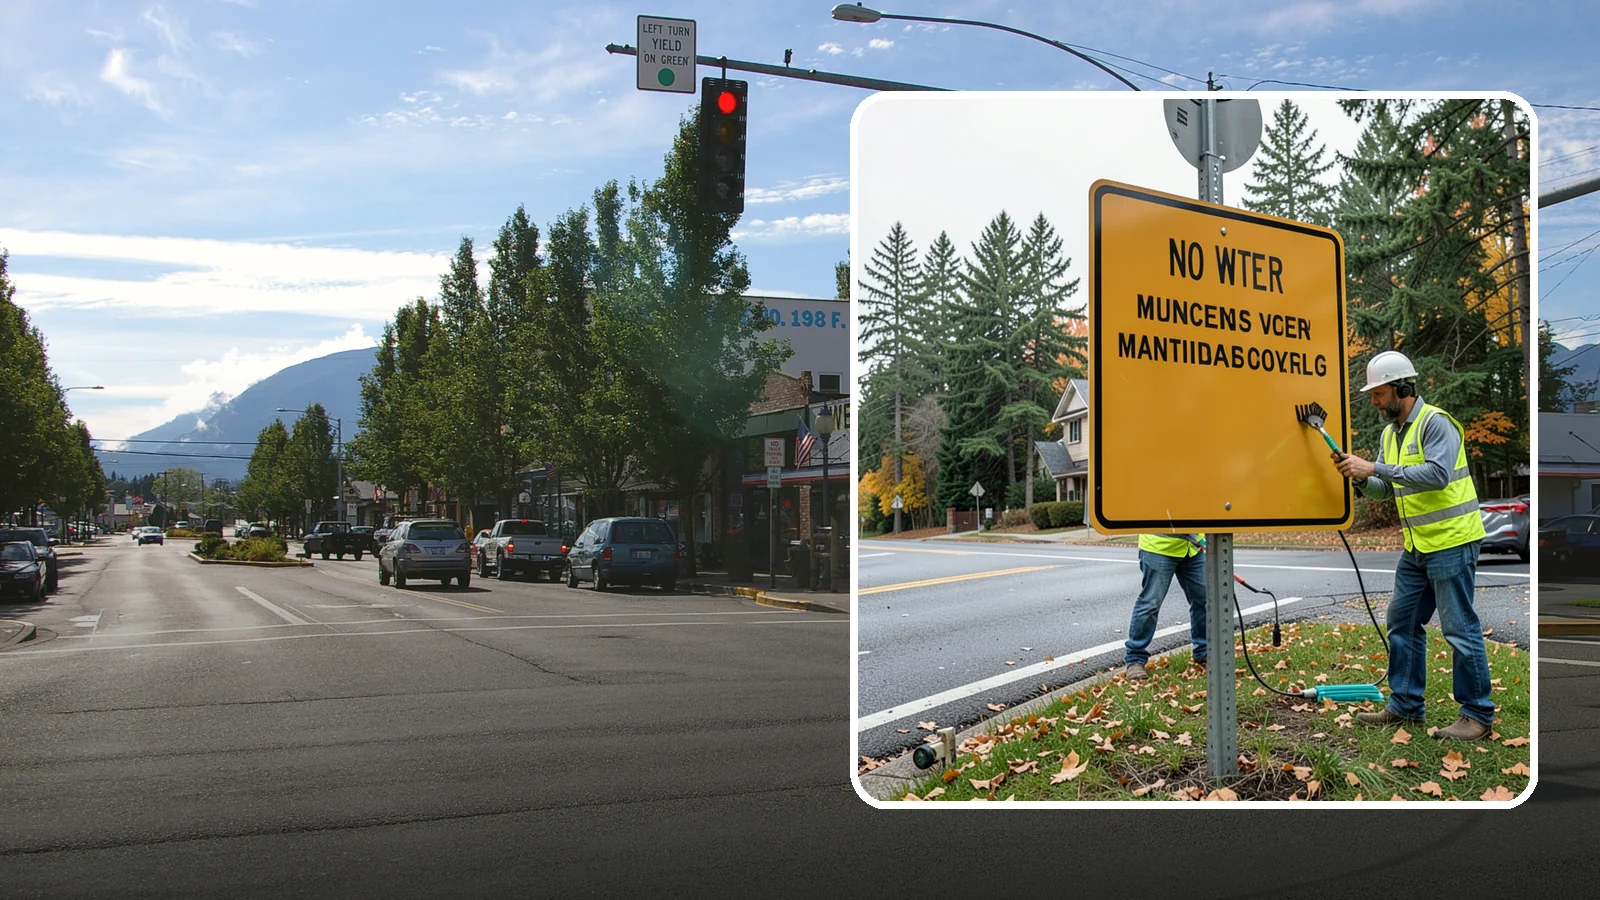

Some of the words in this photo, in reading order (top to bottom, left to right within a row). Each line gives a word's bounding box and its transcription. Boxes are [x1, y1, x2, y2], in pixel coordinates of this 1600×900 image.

[643, 23, 663, 34] LEFT
[668, 25, 690, 36] TURN
[652, 37, 682, 51] YIELD
[644, 53, 656, 64] ON
[661, 54, 689, 66] GREEN
[1169, 237, 1204, 281] NO
[1215, 244, 1284, 294] WTER
[791, 309, 826, 328] 198
[1137, 294, 1252, 333] MUNCENS
